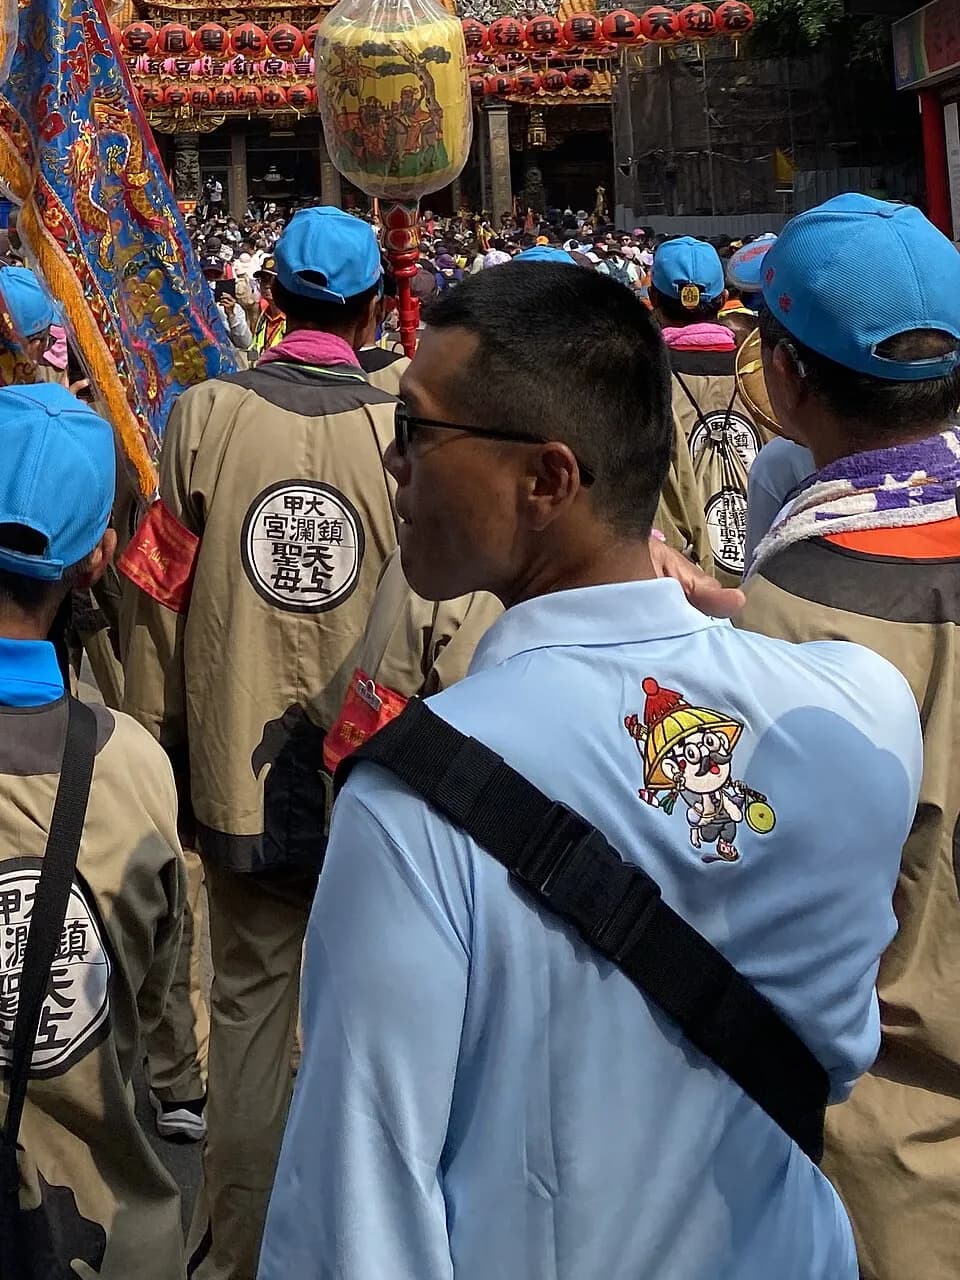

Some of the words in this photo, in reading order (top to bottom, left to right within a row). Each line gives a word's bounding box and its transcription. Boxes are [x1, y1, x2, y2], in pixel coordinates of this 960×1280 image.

[283, 495, 326, 517] 大甲
[263, 513, 344, 545] 鎮瀾宮
